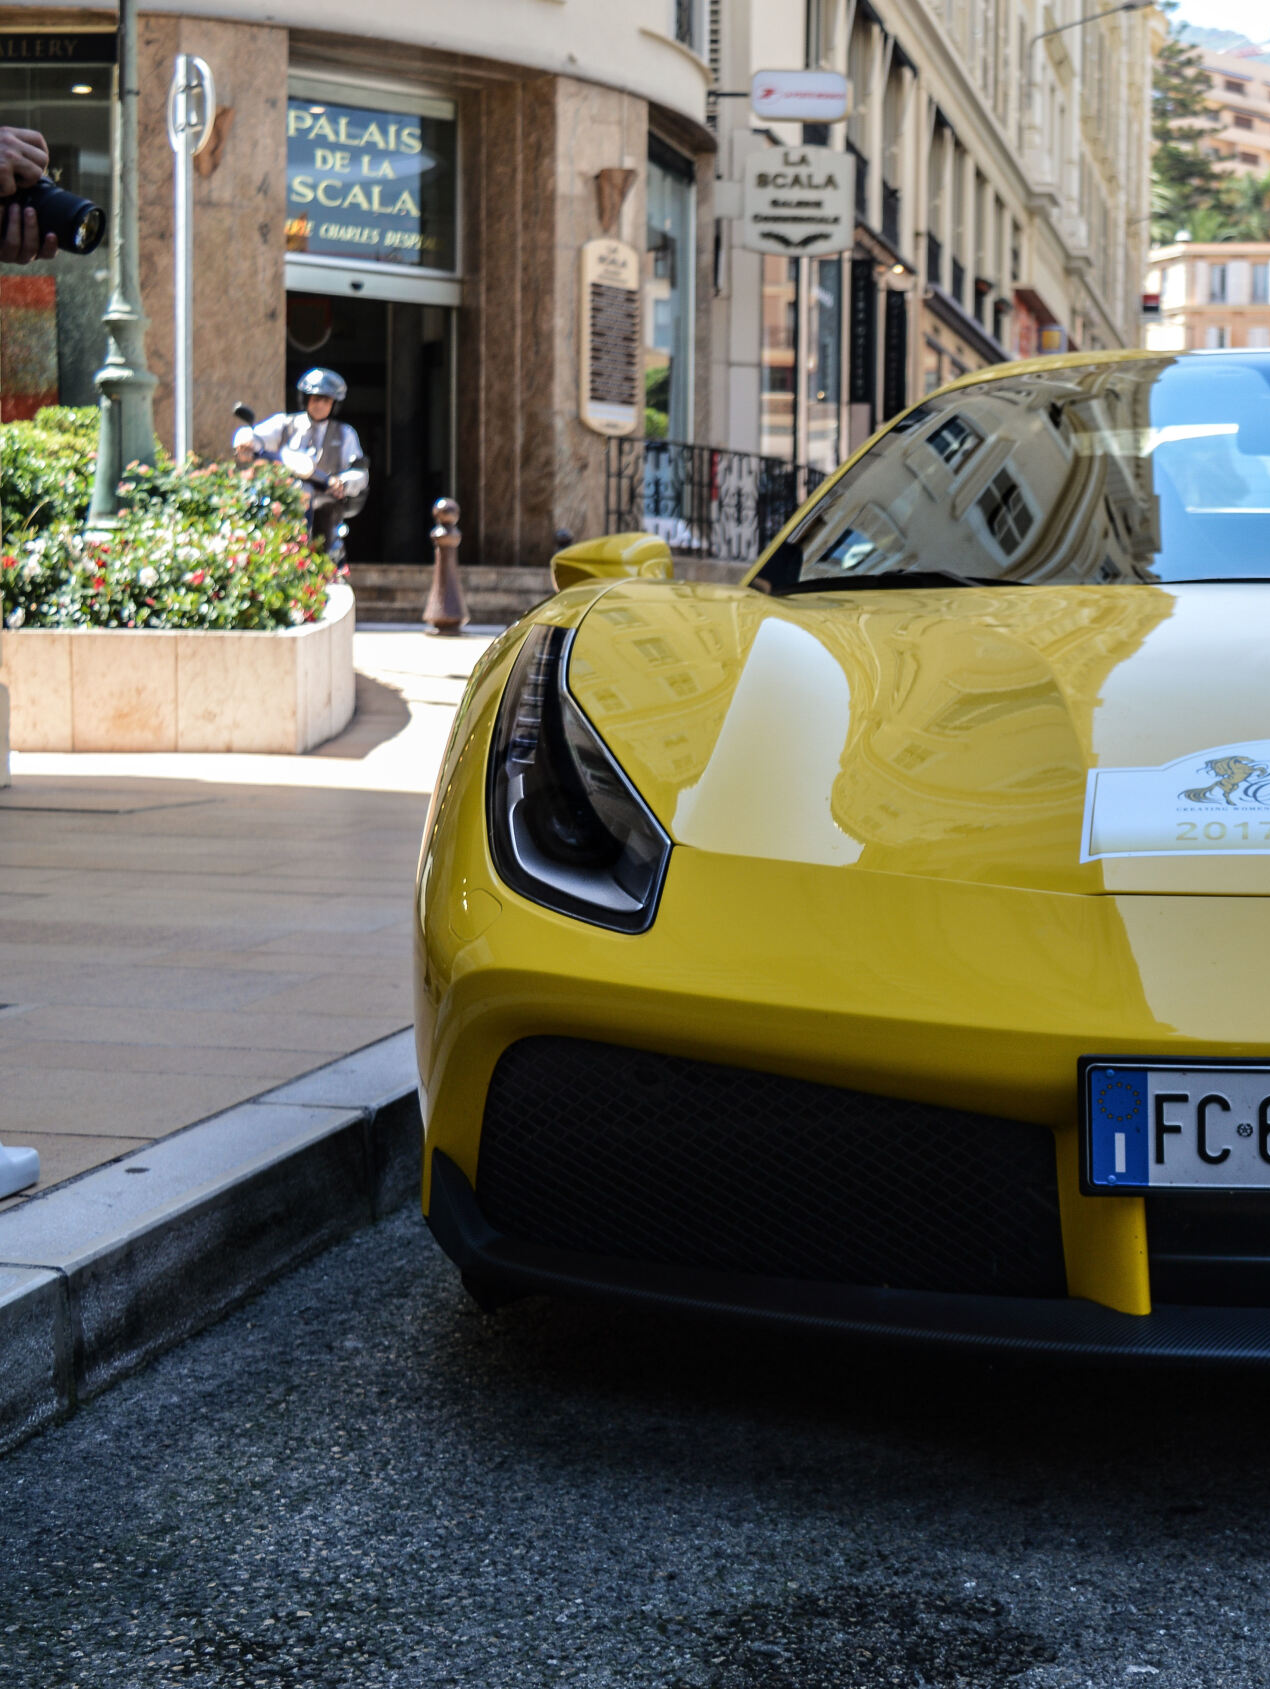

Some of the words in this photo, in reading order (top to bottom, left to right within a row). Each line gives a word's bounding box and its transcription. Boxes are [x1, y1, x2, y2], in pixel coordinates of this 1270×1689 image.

[287, 109, 423, 154] PALAIS
[314, 147, 351, 173] DE
[360, 153, 397, 180] LA
[782, 151, 811, 167] LA
[290, 175, 421, 218] SCALA
[757, 171, 839, 190] SCALA
